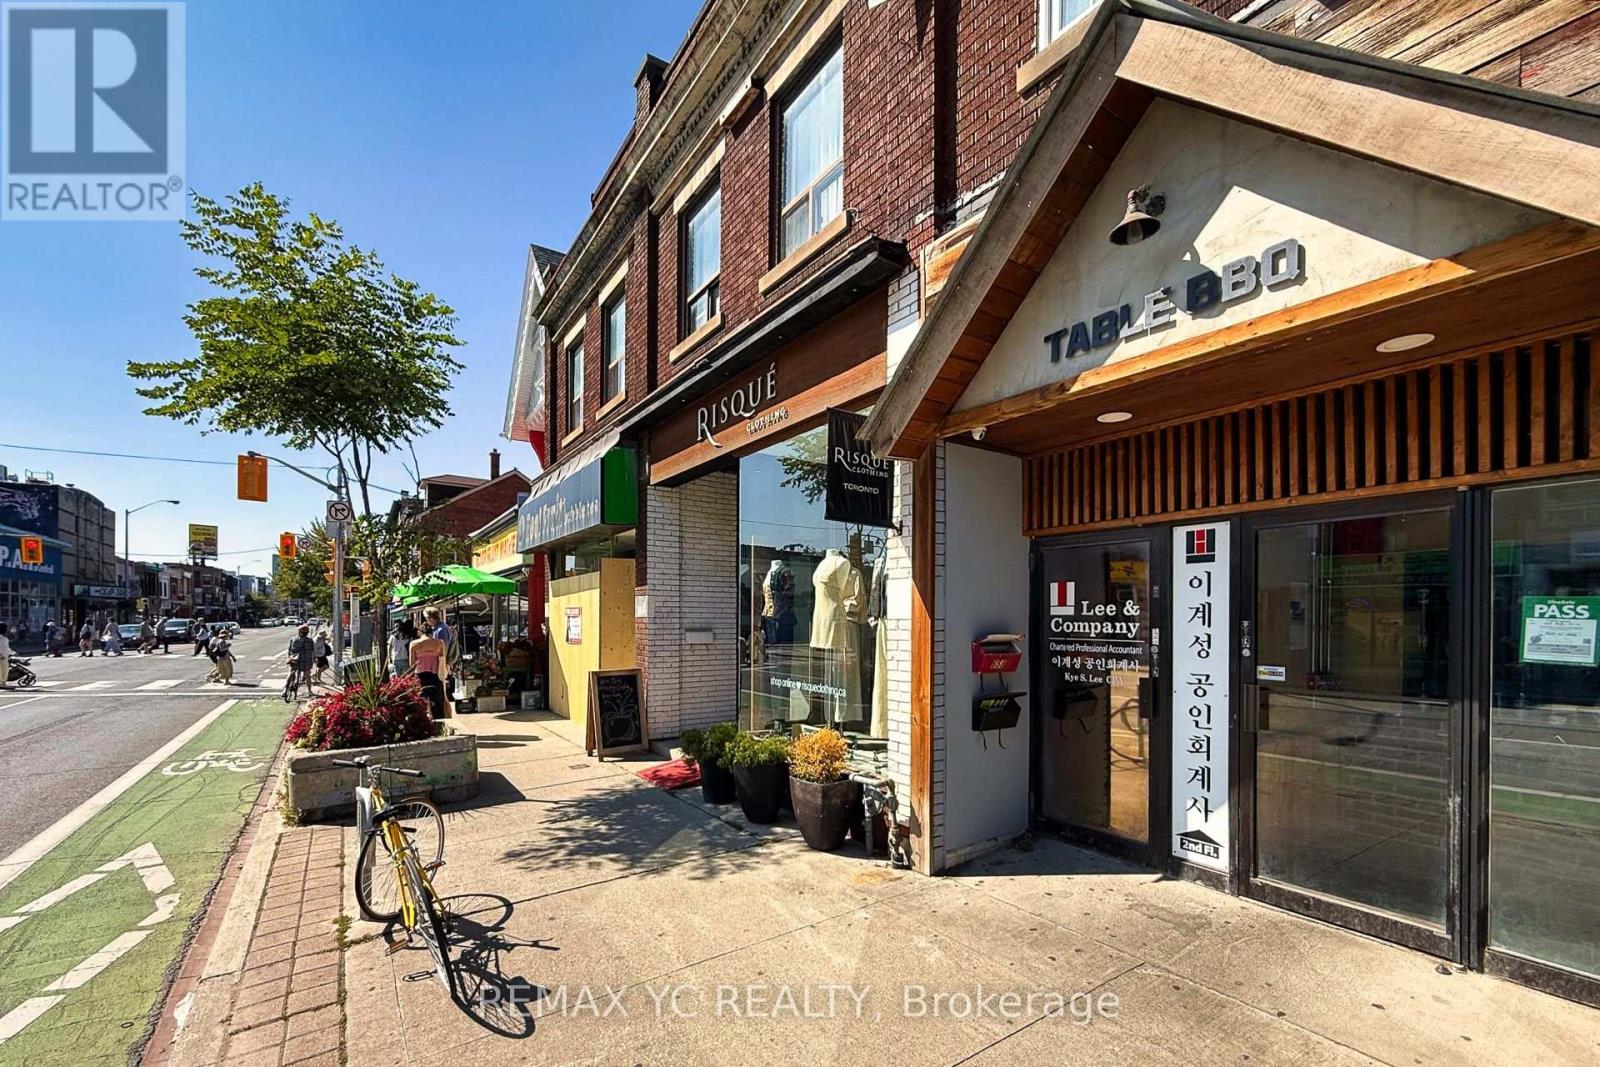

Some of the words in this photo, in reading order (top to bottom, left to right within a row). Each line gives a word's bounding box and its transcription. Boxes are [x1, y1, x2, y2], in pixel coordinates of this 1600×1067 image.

[1043, 287, 1173, 363] TABLE
[1186, 239, 1301, 315] BBQ
[746, 407, 786, 433] CLOTHING
[852, 466, 889, 478] CLOTHING
[842, 482, 879, 495] TORONTO
[1081, 600, 1116, 616] Lee
[1123, 600, 1140, 616] &
[1187, 570, 1213, 659] 이계성
[1534, 604, 1590, 619] PASS
[1050, 618, 1141, 638] Company
[1076, 644, 1108, 653] Professional
[1108, 645, 1142, 655] Accountant
[770, 676, 782, 688] shop
[782, 679, 797, 689] online
[1064, 672, 1079, 682] Kye
[1080, 674, 1088, 682] S.
[1089, 674, 1103, 683] Lee
[1186, 673, 1214, 823] 공인회계사
[1182, 840, 1203, 853] 2nd
